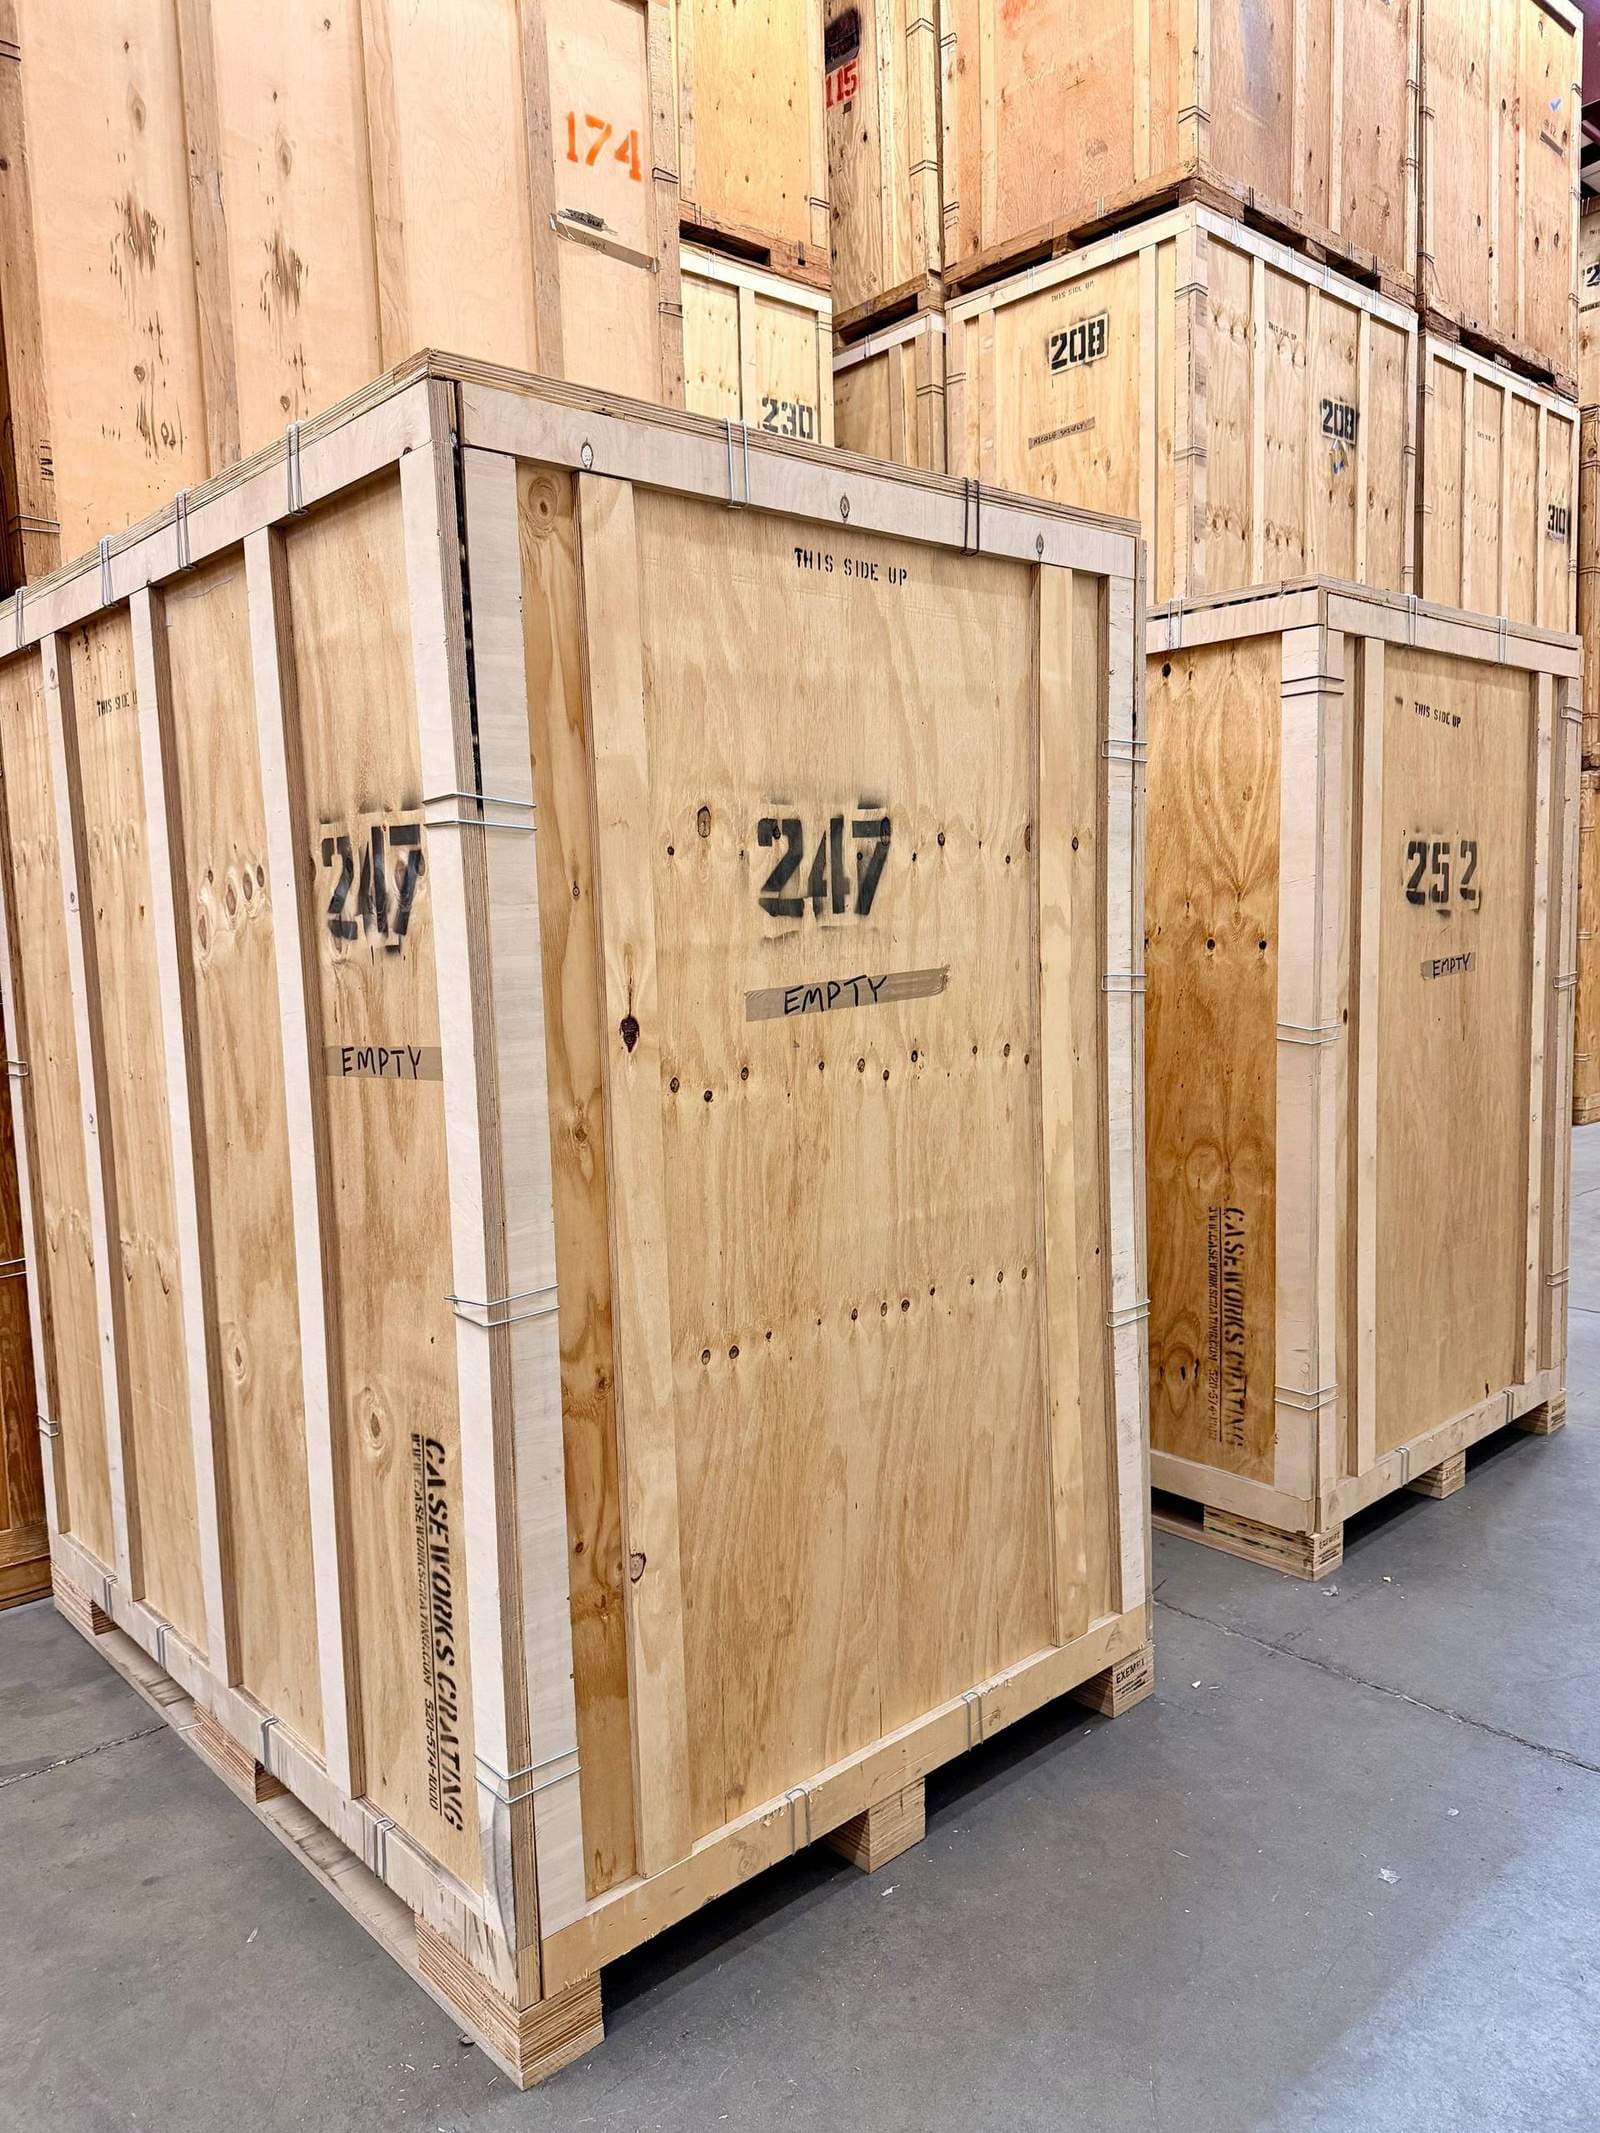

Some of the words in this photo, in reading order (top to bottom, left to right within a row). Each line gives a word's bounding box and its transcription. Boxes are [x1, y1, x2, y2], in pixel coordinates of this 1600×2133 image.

[825, 60, 858, 109] 115
[565, 111, 643, 182] 174
[1050, 318, 1105, 370] 208
[761, 397, 814, 440] 230
[1321, 399, 1356, 441] 208
[1547, 503, 1567, 536] 310
[794, 547, 834, 573] THIS
[843, 558, 879, 582] SIDE
[888, 566, 908, 586] UP
[97, 698, 113, 717] THIS
[114, 692, 130, 710] SIDE
[1414, 701, 1431, 718] THIS
[1433, 709, 1451, 725] SIDE
[1452, 715, 1462, 729] UP
[321, 824, 421, 940] 247
[757, 814, 892, 919] 247
[1405, 839, 1479, 906] 252
[1432, 951, 1472, 979] EMPTY
[783, 974, 888, 1015] EMPTY
[341, 1045, 422, 1081] EMPTY
[1223, 1207, 1245, 1346] CASEWORKS
[1223, 1350, 1246, 1447] CRATING
[425, 1437, 455, 1667] CASEWORKS
[1115, 1658, 1145, 1684] EXEMPT
[424, 1698, 439, 1811] 520-574-1000
[437, 1670, 464, 1832] CRATING
